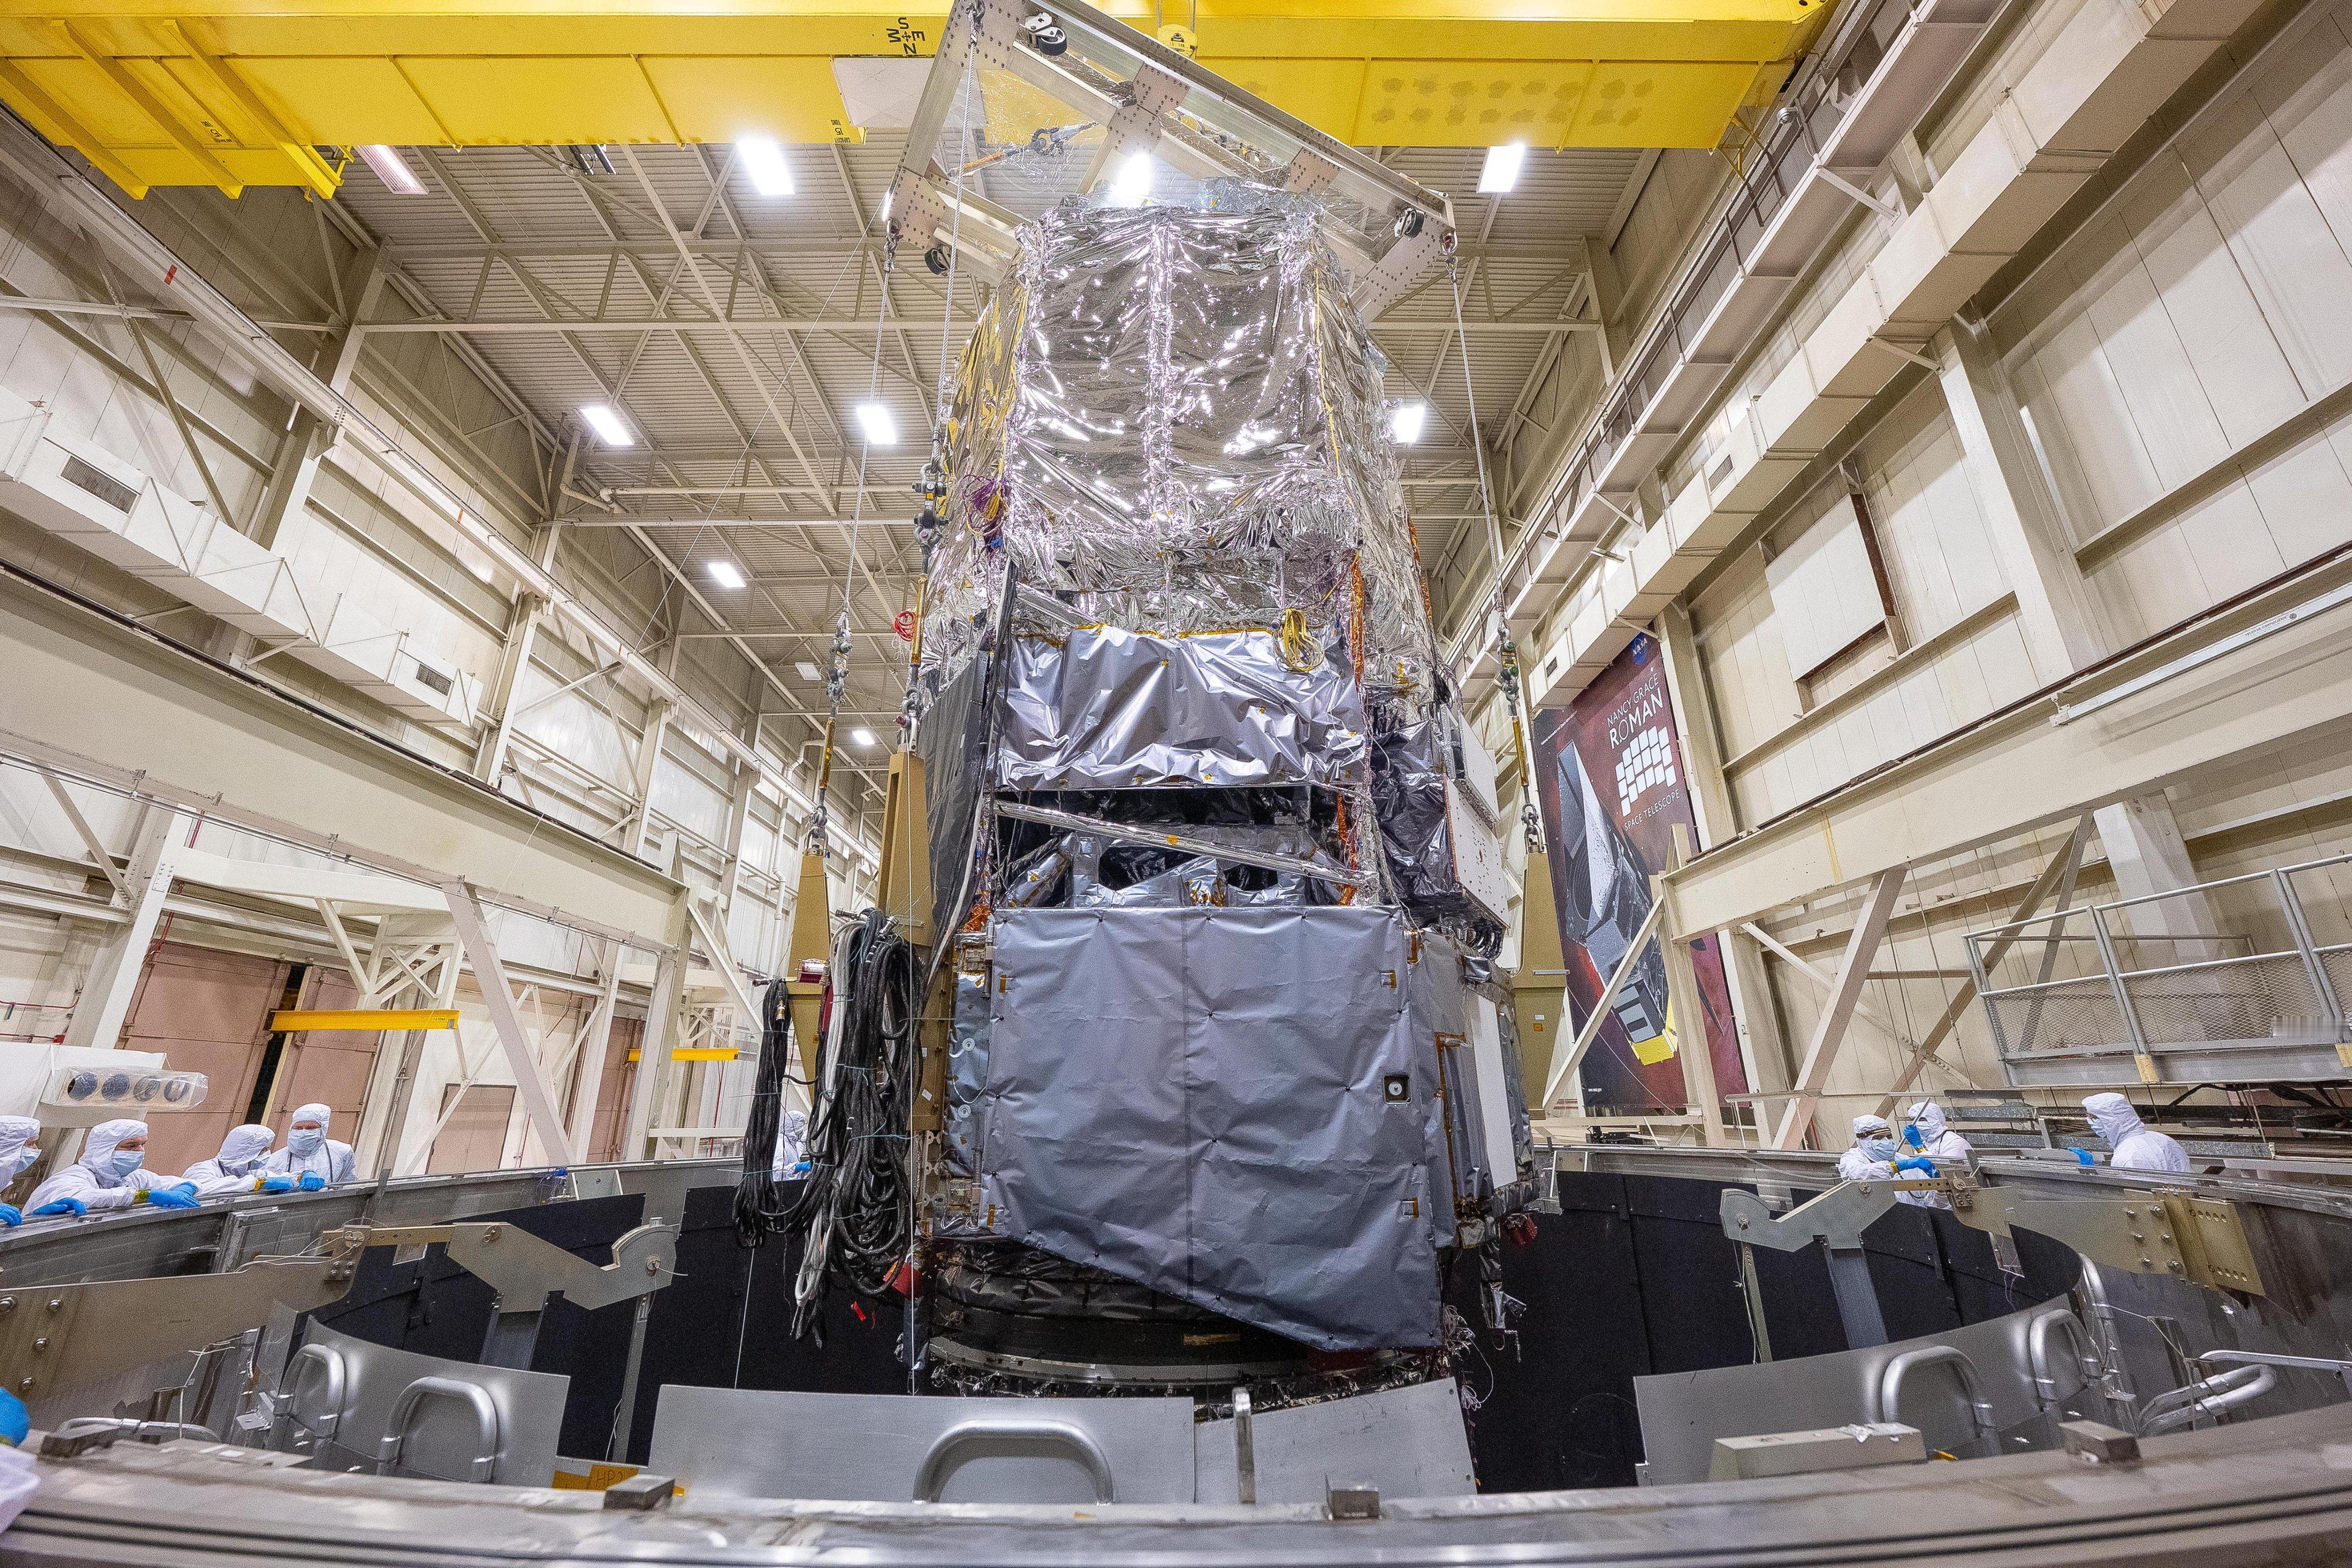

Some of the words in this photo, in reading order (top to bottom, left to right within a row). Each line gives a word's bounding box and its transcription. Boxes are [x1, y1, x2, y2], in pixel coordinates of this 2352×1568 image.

[898, 17, 909, 29] S
[911, 30, 926, 41] E
[903, 42, 917, 54] N
[1633, 638, 1647, 656] NASA
[1607, 696, 1631, 727] NANCY
[1633, 672, 1659, 704] GRACE
[1609, 687, 1664, 750] ROMAN
[1624, 813, 1643, 831] SPACE
[1643, 789, 1680, 819] TELESCOPE
